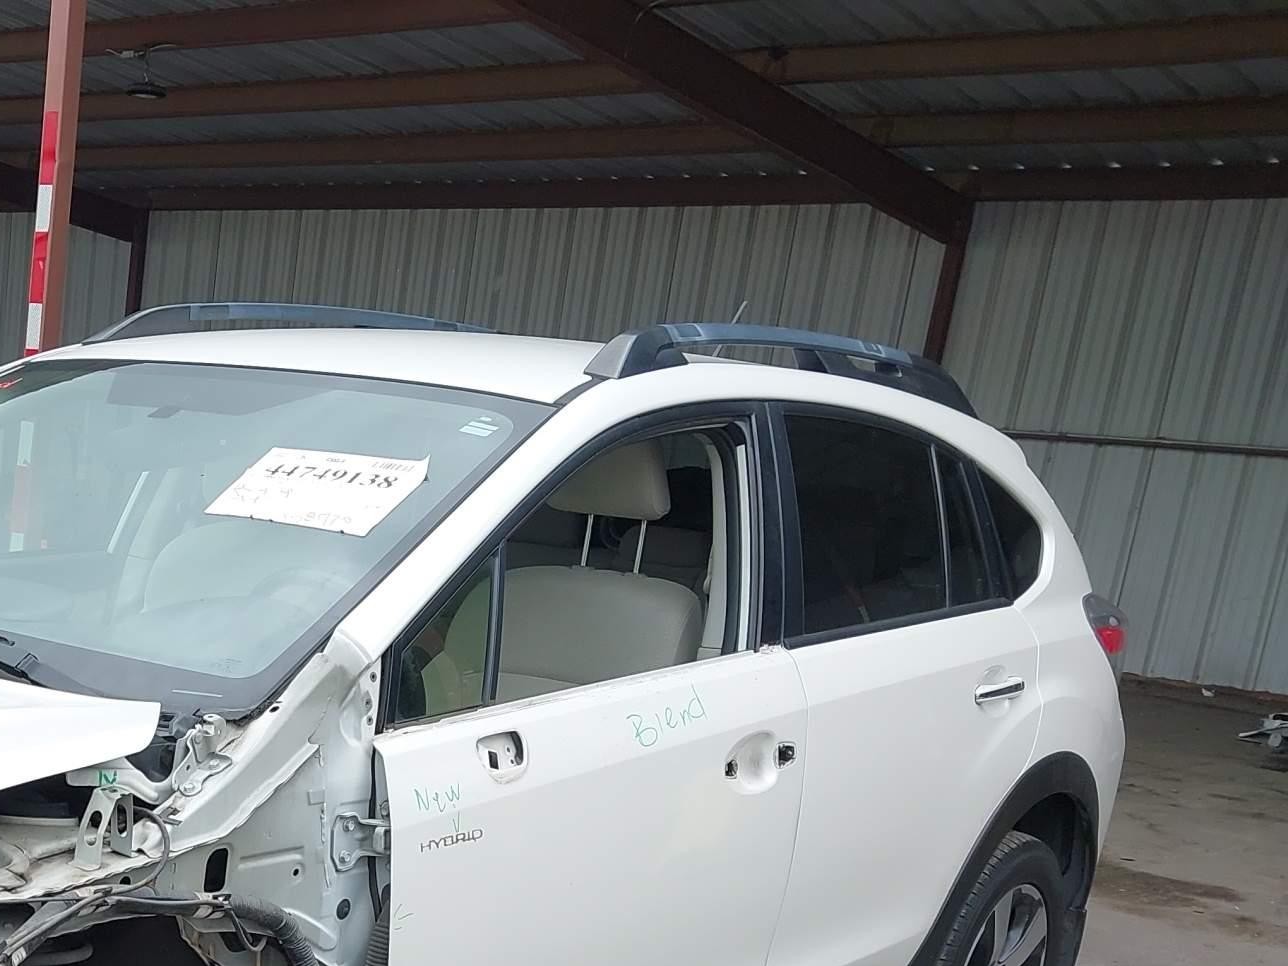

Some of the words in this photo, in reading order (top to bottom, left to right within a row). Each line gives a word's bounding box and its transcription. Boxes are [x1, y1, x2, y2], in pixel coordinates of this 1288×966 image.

[265, 464, 398, 489] 44749138
[626, 683, 709, 747] Blend
[414, 783, 460, 813] New
[420, 829, 483, 852] HYBRID
